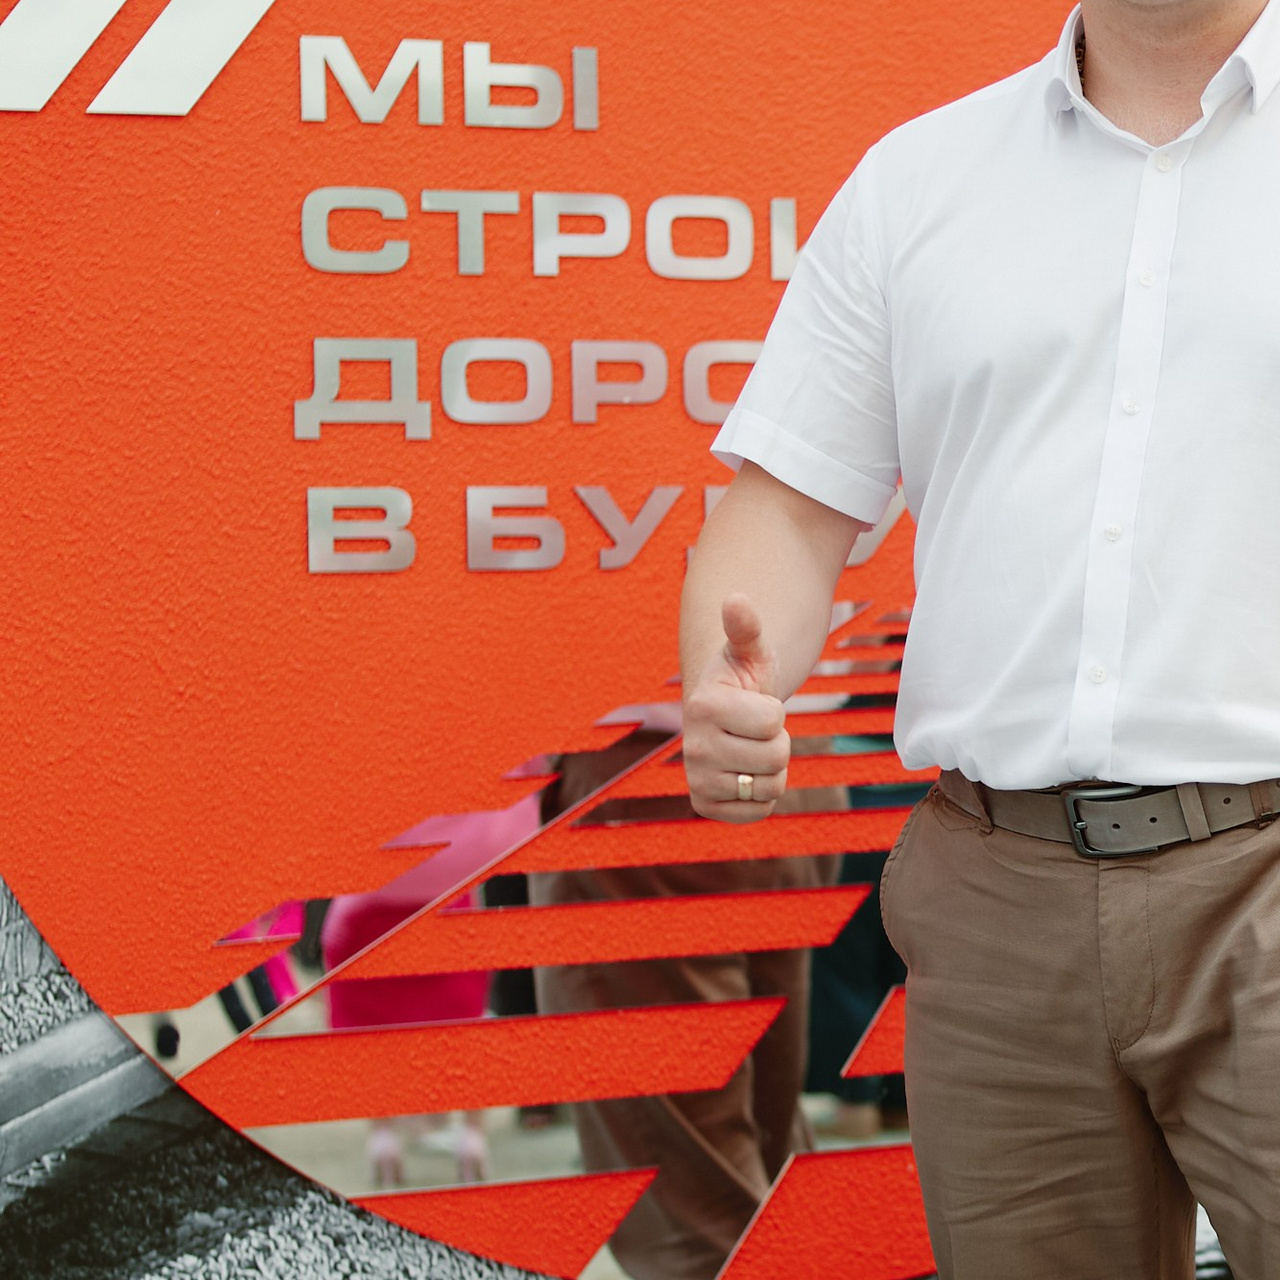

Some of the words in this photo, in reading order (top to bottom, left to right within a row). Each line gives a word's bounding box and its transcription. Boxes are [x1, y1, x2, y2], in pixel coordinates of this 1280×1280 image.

[300, 35, 598, 131] МЫ
[301, 187, 804, 281] СТРО
[294, 338, 766, 440] ДОРО
[307, 487, 416, 574] В
